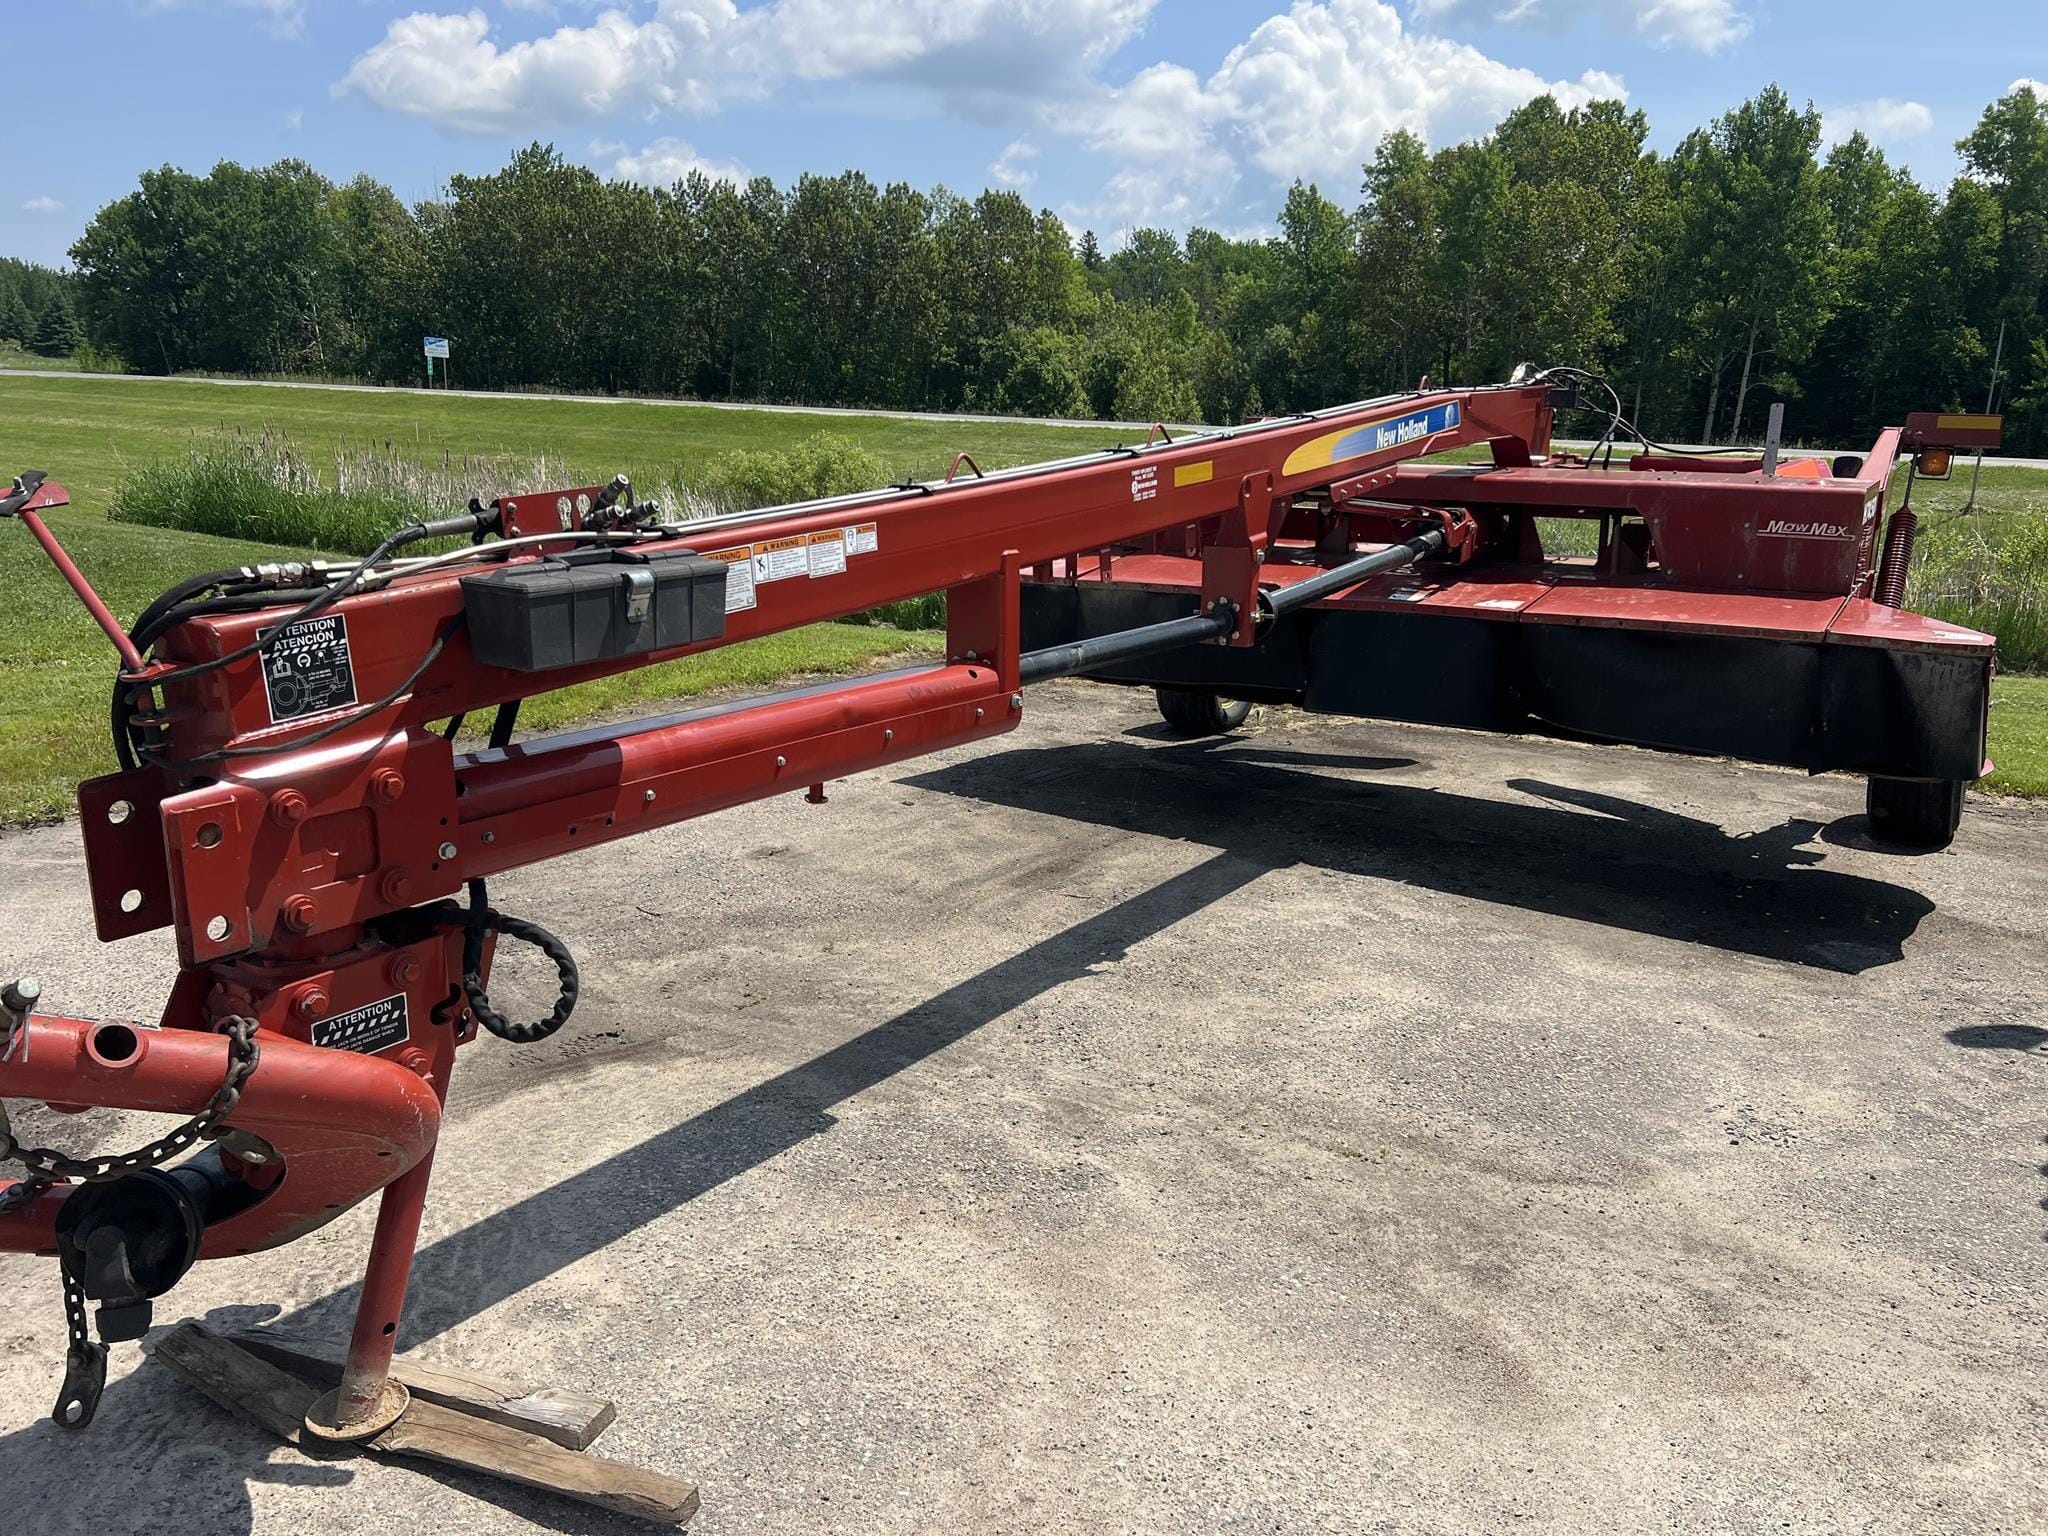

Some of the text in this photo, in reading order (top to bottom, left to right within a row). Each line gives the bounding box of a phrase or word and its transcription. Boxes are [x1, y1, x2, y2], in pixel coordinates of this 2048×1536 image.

[1376, 415, 1428, 449] New Holland
[769, 539, 800, 550] WARNING
[817, 532, 841, 541] WARNING
[279, 618, 336, 637] TENTION
[273, 630, 334, 651] ATENCIÓN
[328, 1001, 392, 1032] ATTENTION
